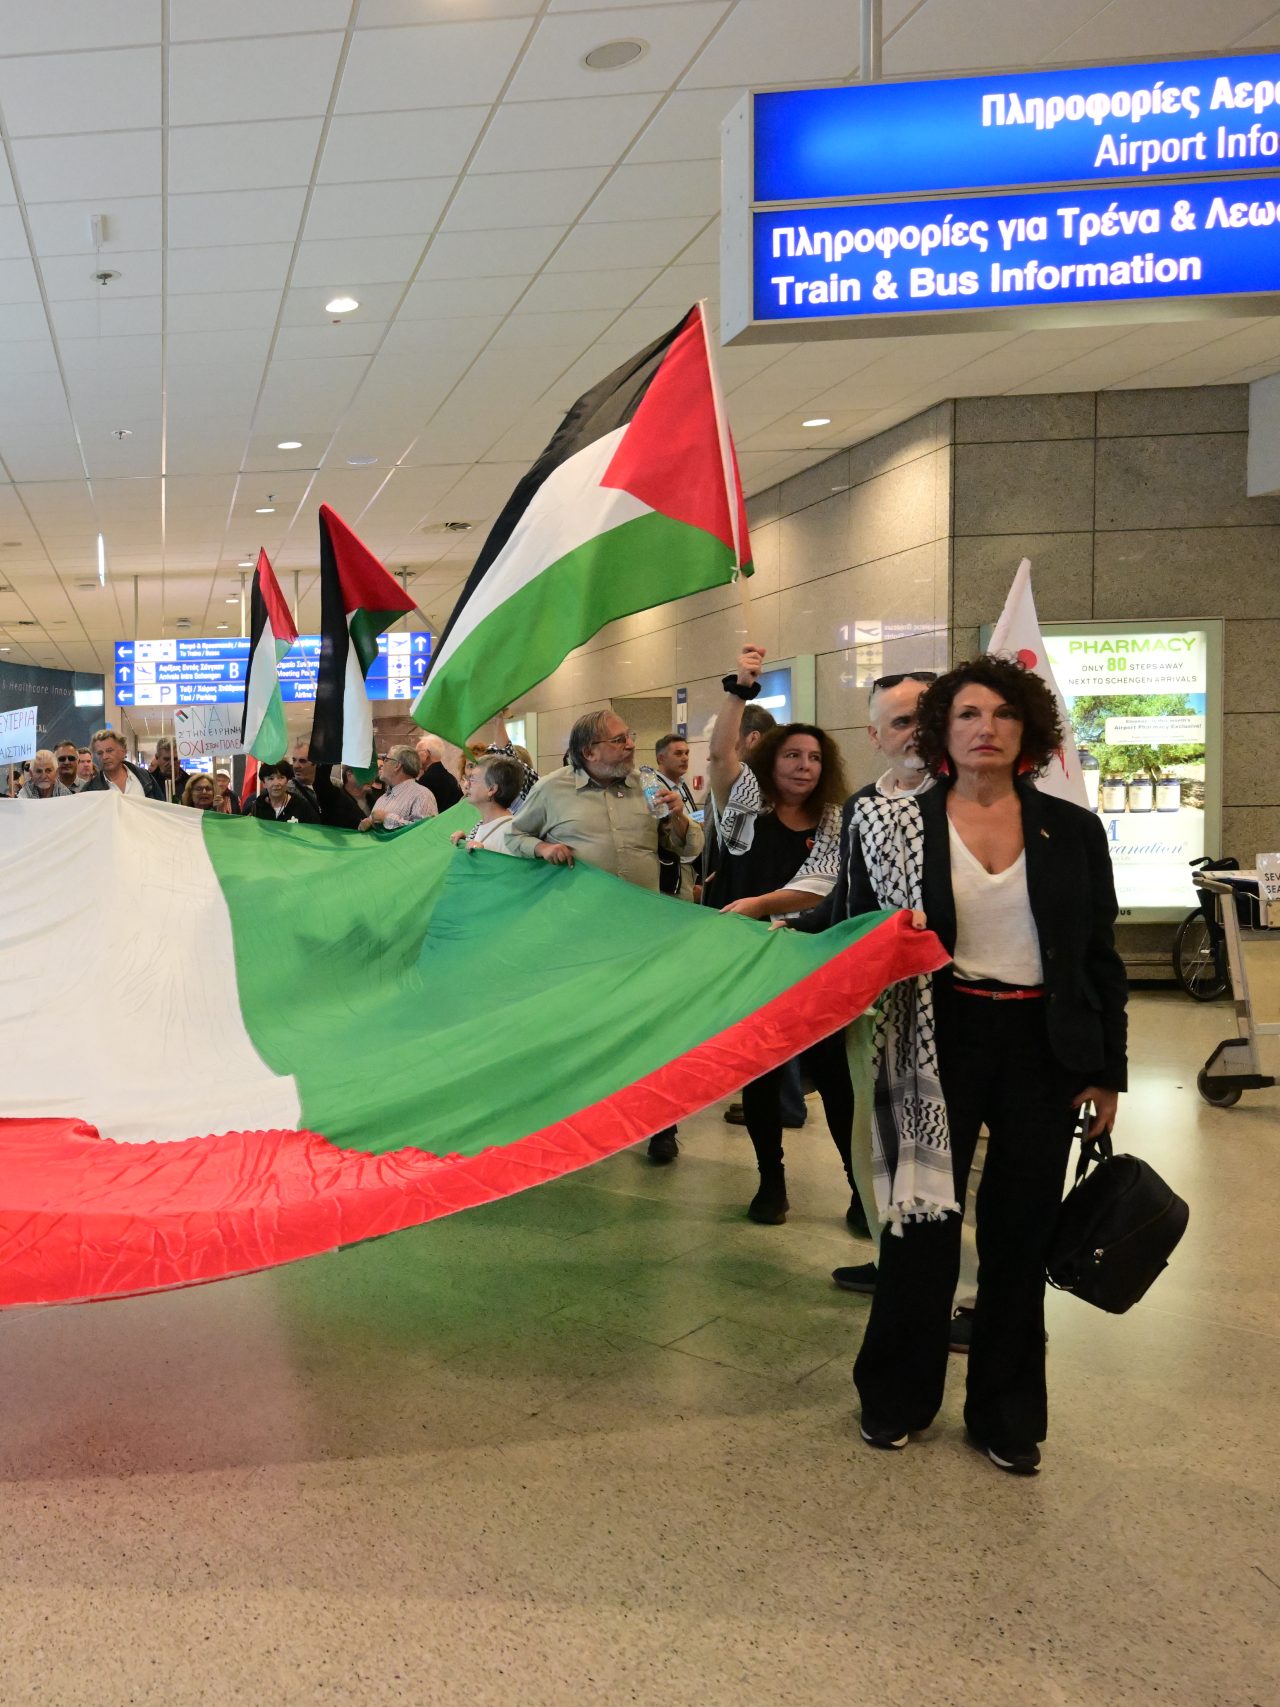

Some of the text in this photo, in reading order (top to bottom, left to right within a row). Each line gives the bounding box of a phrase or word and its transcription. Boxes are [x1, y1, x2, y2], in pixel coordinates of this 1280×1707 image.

[982, 77, 1280, 130] Πληροφορίες Αερ
[1093, 123, 1279, 172] Airport Info
[772, 197, 1280, 262] Πληροφορίες για Τρένα & Λεω
[772, 256, 1202, 306] Train & Bus Information
[1069, 638, 1197, 654] PHARMACY
[229, 662, 239, 679] B
[1082, 657, 1183, 672] ONLY 80 STEPS AWAY
[276, 670, 303, 678] Meeting
[1105, 677, 1153, 685] SCHENGEN
[9, 681, 49, 694] Healthcare
[51, 685, 72, 697] Innov
[178, 739, 205, 757] ΟΧΙ
[220, 739, 243, 750] ΠΟΛΕ
